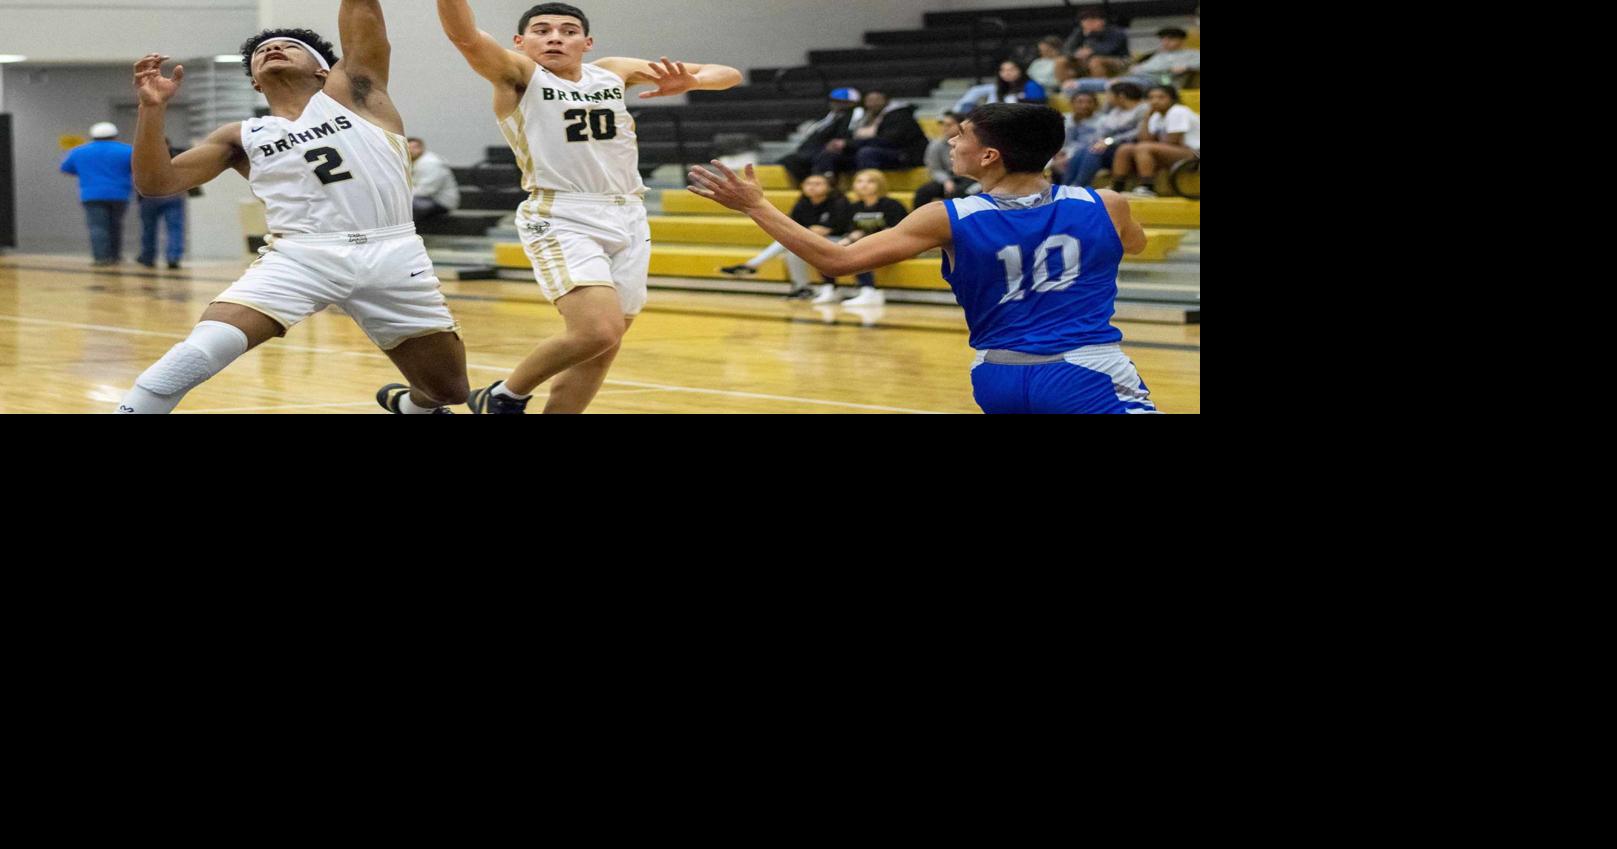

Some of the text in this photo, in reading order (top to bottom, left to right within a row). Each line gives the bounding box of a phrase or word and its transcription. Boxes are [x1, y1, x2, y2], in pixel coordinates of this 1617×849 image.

[259, 115, 352, 157] BRAHMS
[562, 108, 617, 143] 20
[303, 146, 354, 186] 2
[997, 233, 1080, 304] 10
